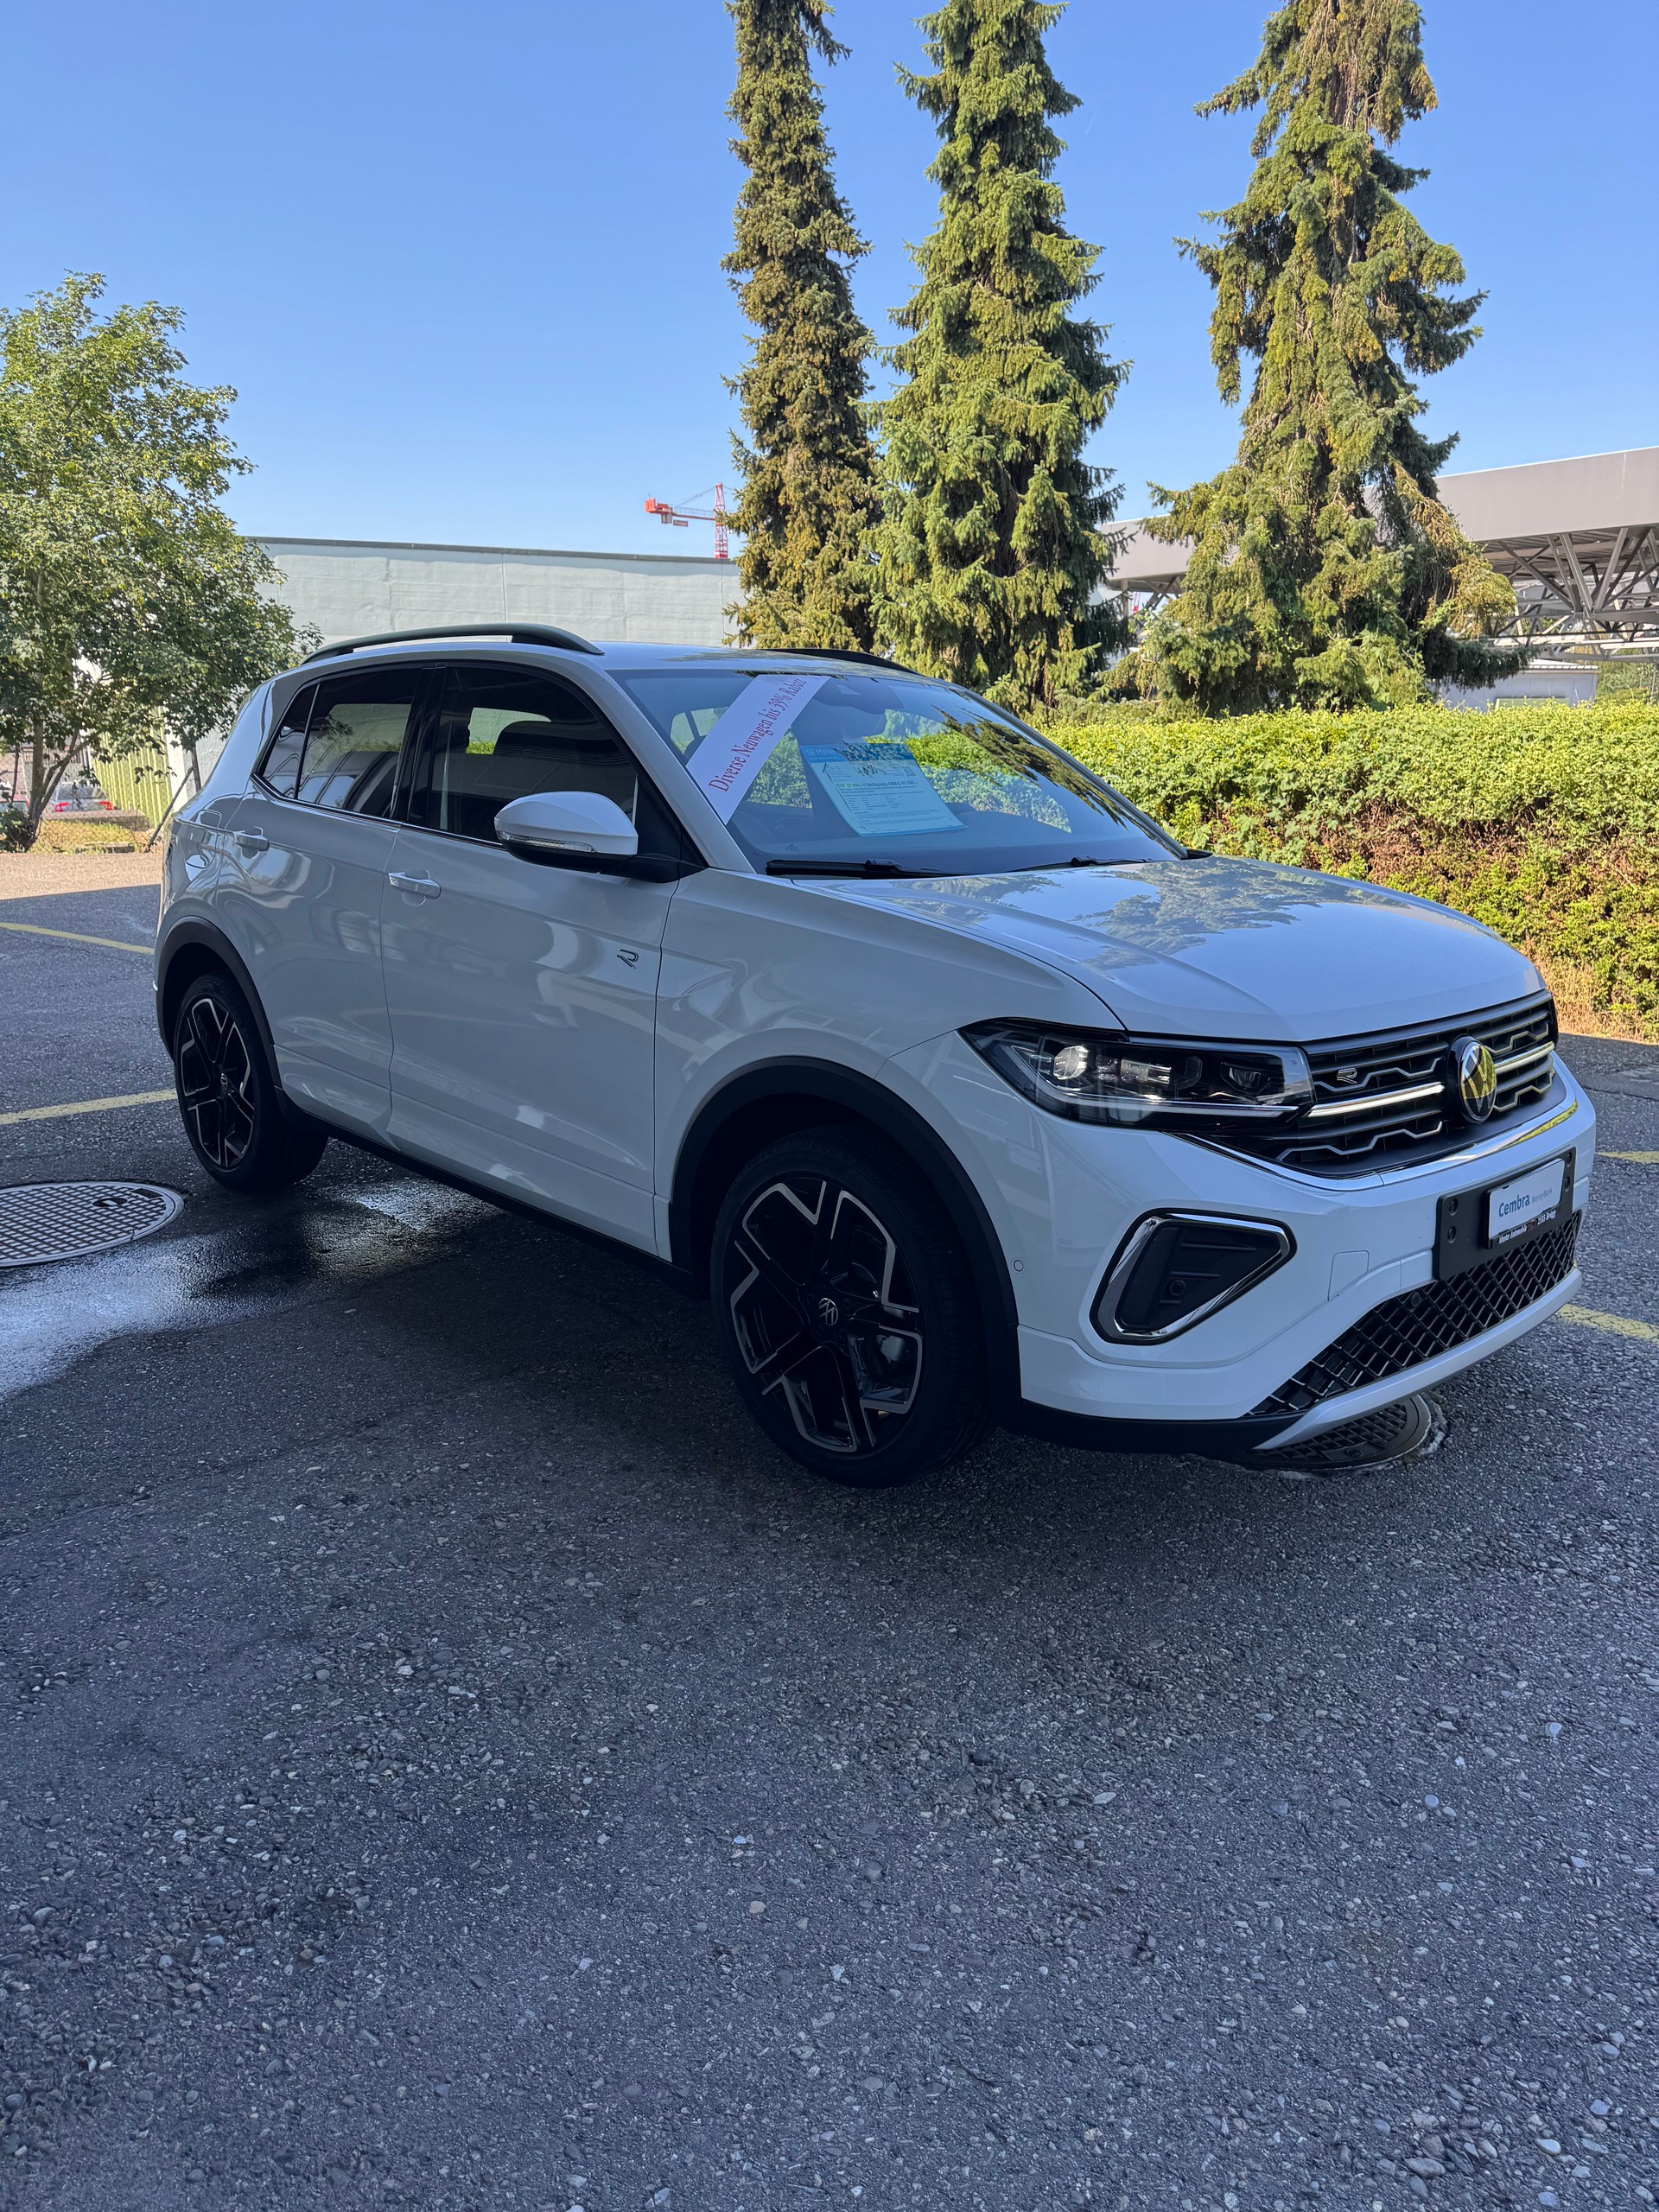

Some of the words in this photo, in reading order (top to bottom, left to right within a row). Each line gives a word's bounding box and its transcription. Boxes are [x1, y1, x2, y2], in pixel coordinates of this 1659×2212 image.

[779, 678, 807, 696] Rabatt
[768, 693, 792, 711] 39%
[758, 709, 782, 721] bis
[731, 718, 774, 758] Neuwagen
[708, 753, 747, 793] Diverse
[1498, 1194, 1530, 1217] Cembra
